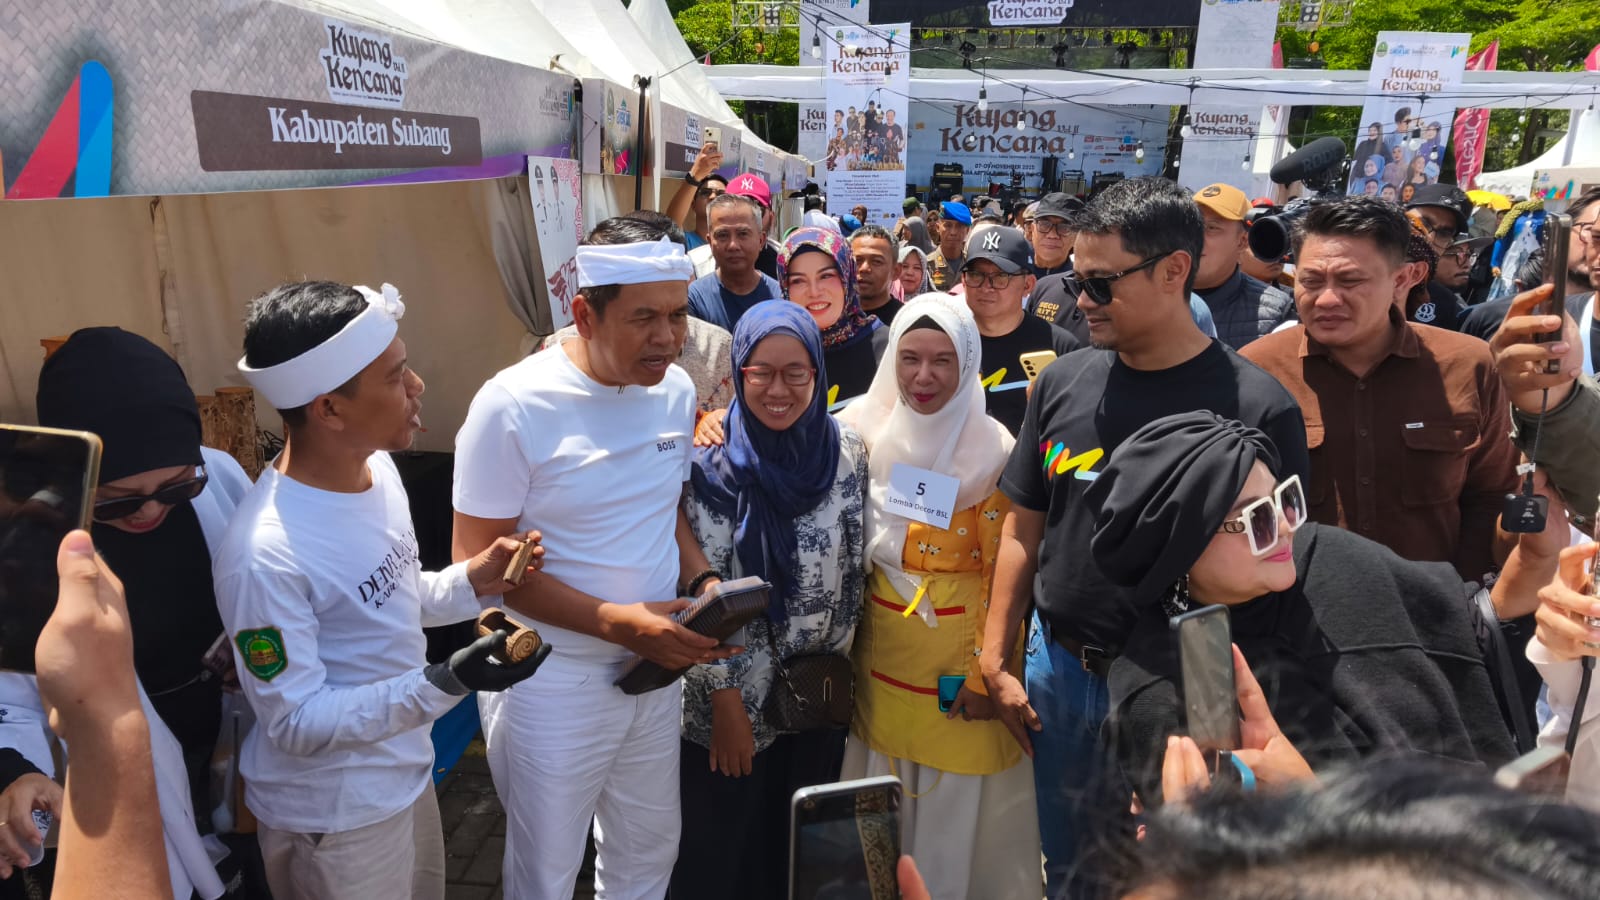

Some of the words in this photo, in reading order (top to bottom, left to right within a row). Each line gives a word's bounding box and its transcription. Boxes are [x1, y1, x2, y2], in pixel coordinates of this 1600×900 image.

[991, 4, 1064, 20] Kencana
[327, 25, 392, 69] Kujang
[322, 55, 402, 96] Kencana
[1390, 67, 1439, 81] Kujang
[1381, 78, 1442, 92] Kencana
[953, 104, 1057, 134] Kujang
[1195, 111, 1249, 125] Kujang
[267, 106, 390, 154] Kabupaten
[391, 115, 452, 156] Subang
[938, 127, 1067, 154] Kencana
[982, 231, 1001, 250] NY
[656, 440, 676, 452] BOSS
[915, 482, 927, 496] 5
[889, 496, 913, 509] Lomba
[914, 503, 935, 515] Decor
[935, 510, 950, 520] BSL
